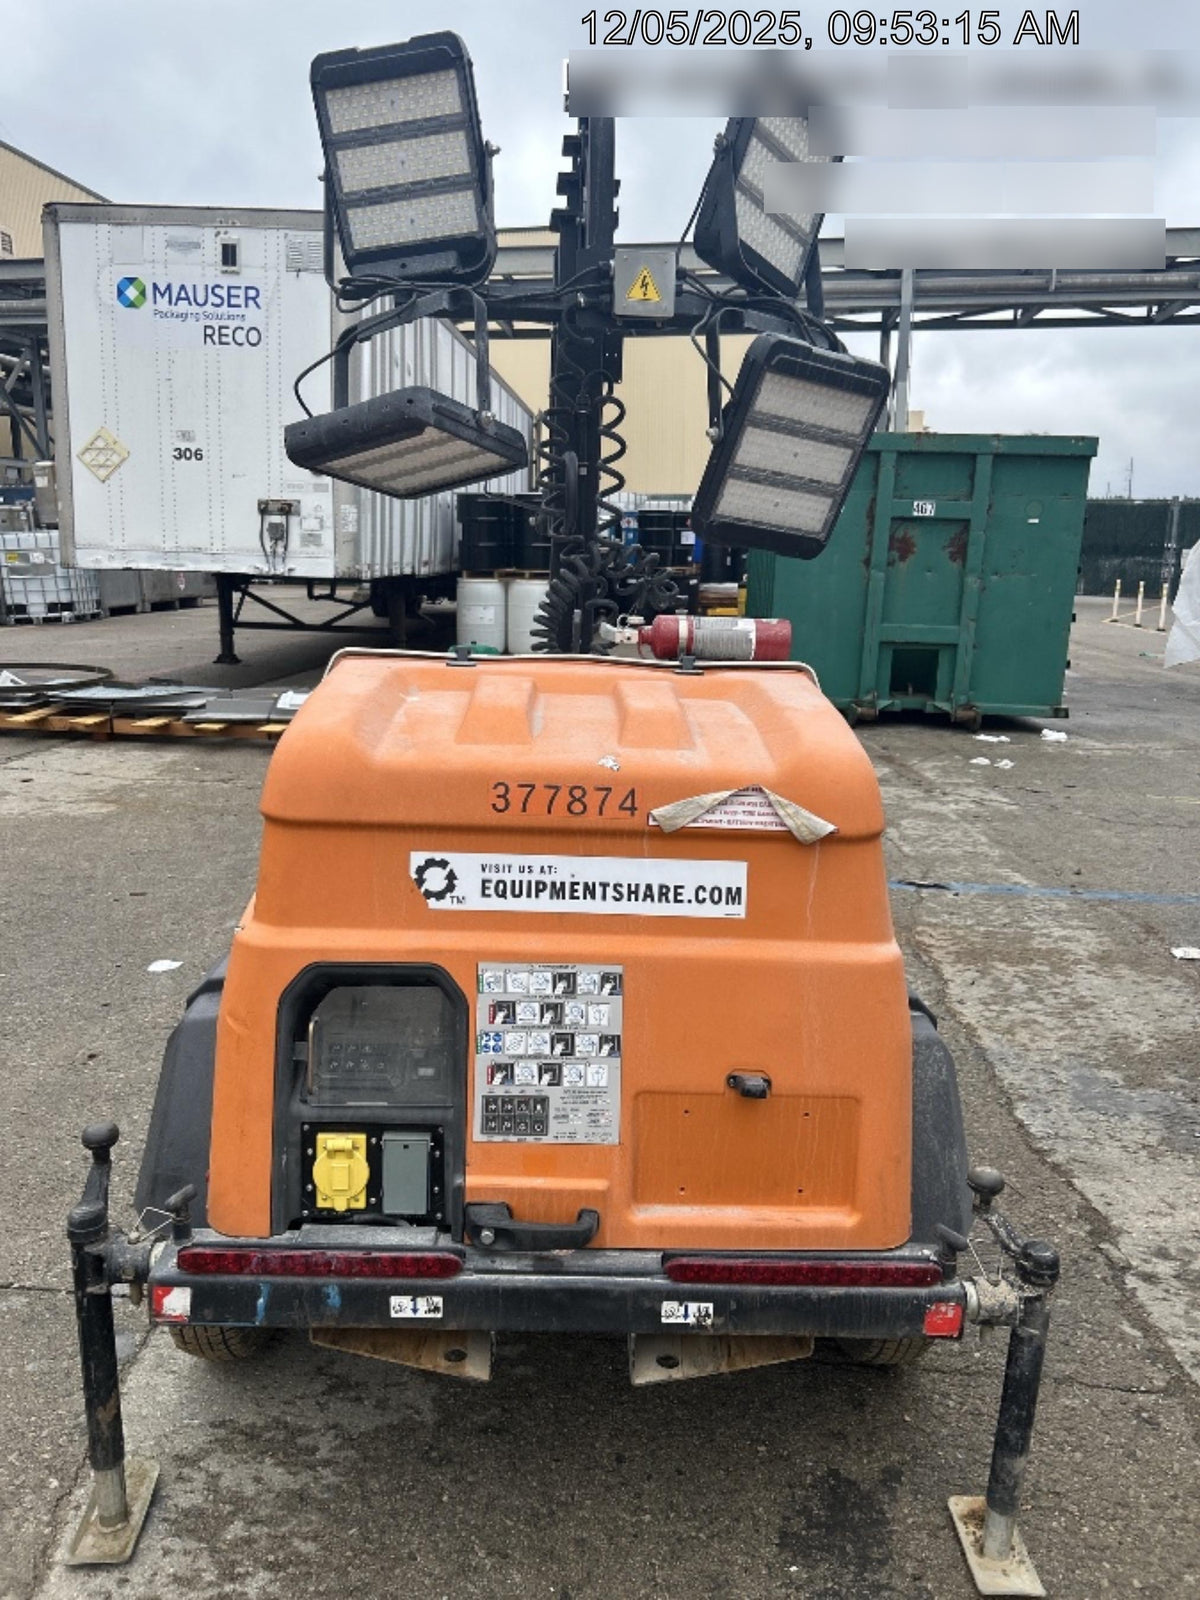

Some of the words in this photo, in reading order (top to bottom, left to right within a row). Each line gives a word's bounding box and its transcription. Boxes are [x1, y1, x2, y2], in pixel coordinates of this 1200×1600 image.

[152, 281, 262, 310] MAUSER
[153, 308, 201, 323] Packaging
[202, 310, 246, 323] Solutions
[203, 324, 262, 348] RECO
[172, 447, 204, 462] 306
[913, 501, 935, 515] 467
[491, 781, 639, 818] 377874
[480, 863, 513, 874] VISIT
[518, 864, 534, 875] US
[538, 865, 558, 876] AT:
[480, 877, 743, 906] EQUIPMENTSHARE.COM
